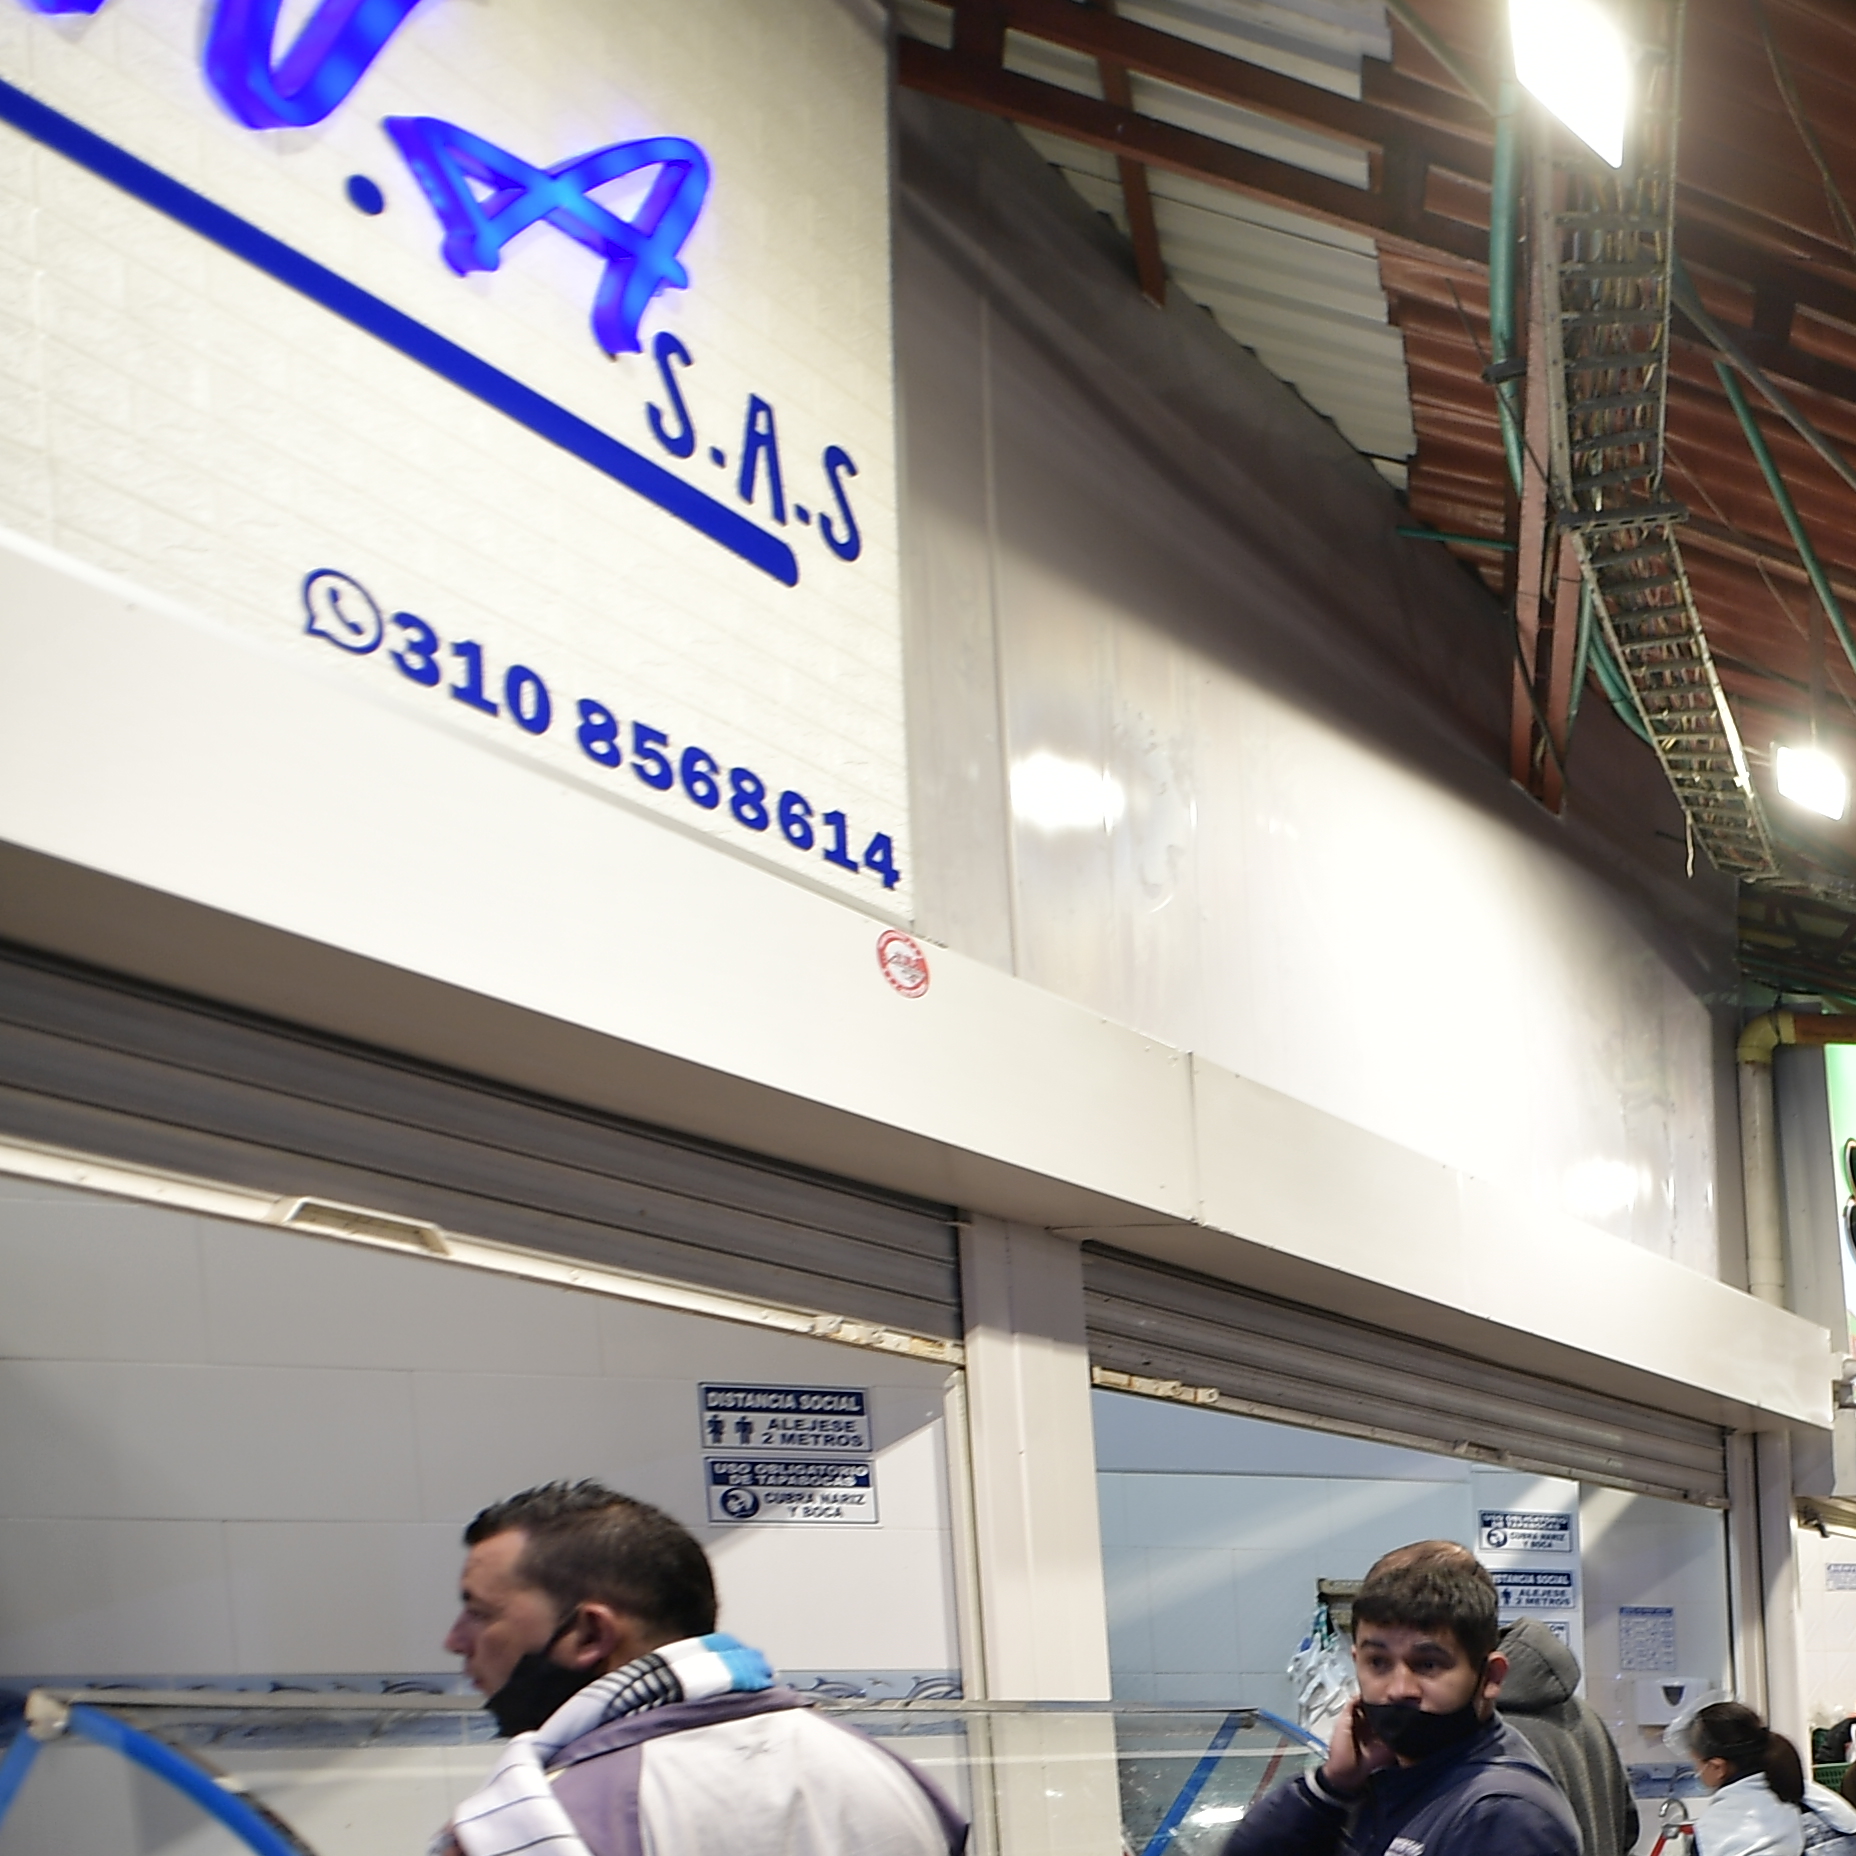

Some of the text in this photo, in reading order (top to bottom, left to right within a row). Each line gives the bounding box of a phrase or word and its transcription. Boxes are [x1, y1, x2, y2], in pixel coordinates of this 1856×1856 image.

[646, 331, 863, 563] S.A.S
[388, 611, 902, 891] 310 8568614
[706, 1391, 862, 1412] DISTANCIA SOCIAL
[767, 1418, 857, 1433] ALEJESE
[761, 1432, 864, 1447] 2 METROS
[714, 1462, 869, 1477] USO OBLIGATORIO
[728, 1474, 858, 1487] DE TAPABOCAS
[764, 1491, 867, 1506] CUBRA NARIZ
[788, 1506, 843, 1519] Y BOCA
[1492, 1573, 1535, 1585] STANCIA
